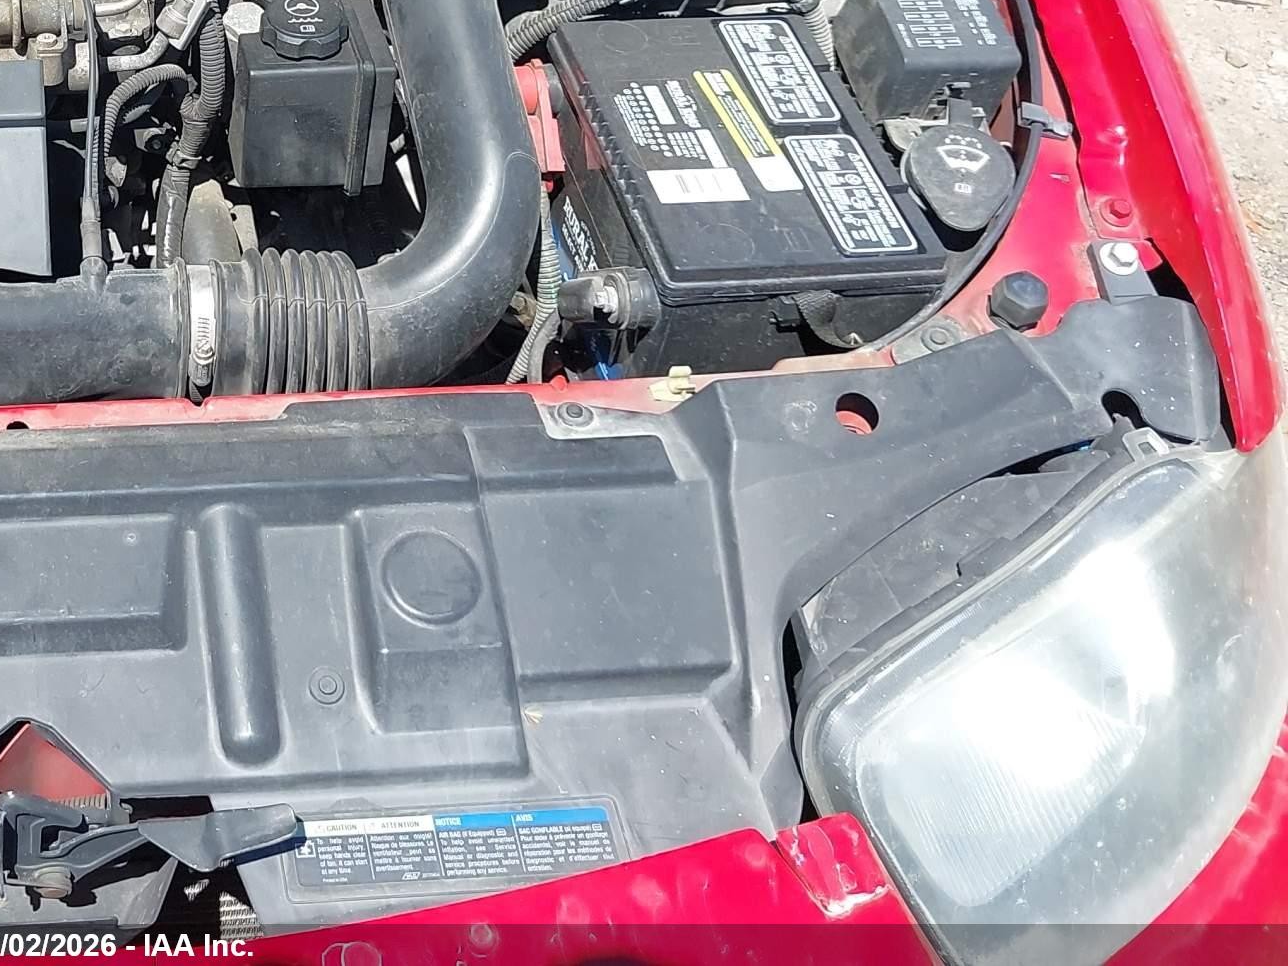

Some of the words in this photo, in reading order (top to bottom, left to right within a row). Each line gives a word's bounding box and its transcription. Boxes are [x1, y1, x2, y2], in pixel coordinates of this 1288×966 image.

[434, 817, 461, 827] NOTICE
[516, 814, 534, 823] AVIS
[326, 823, 358, 832] CAUTION
[381, 821, 420, 829] ATTENTION
